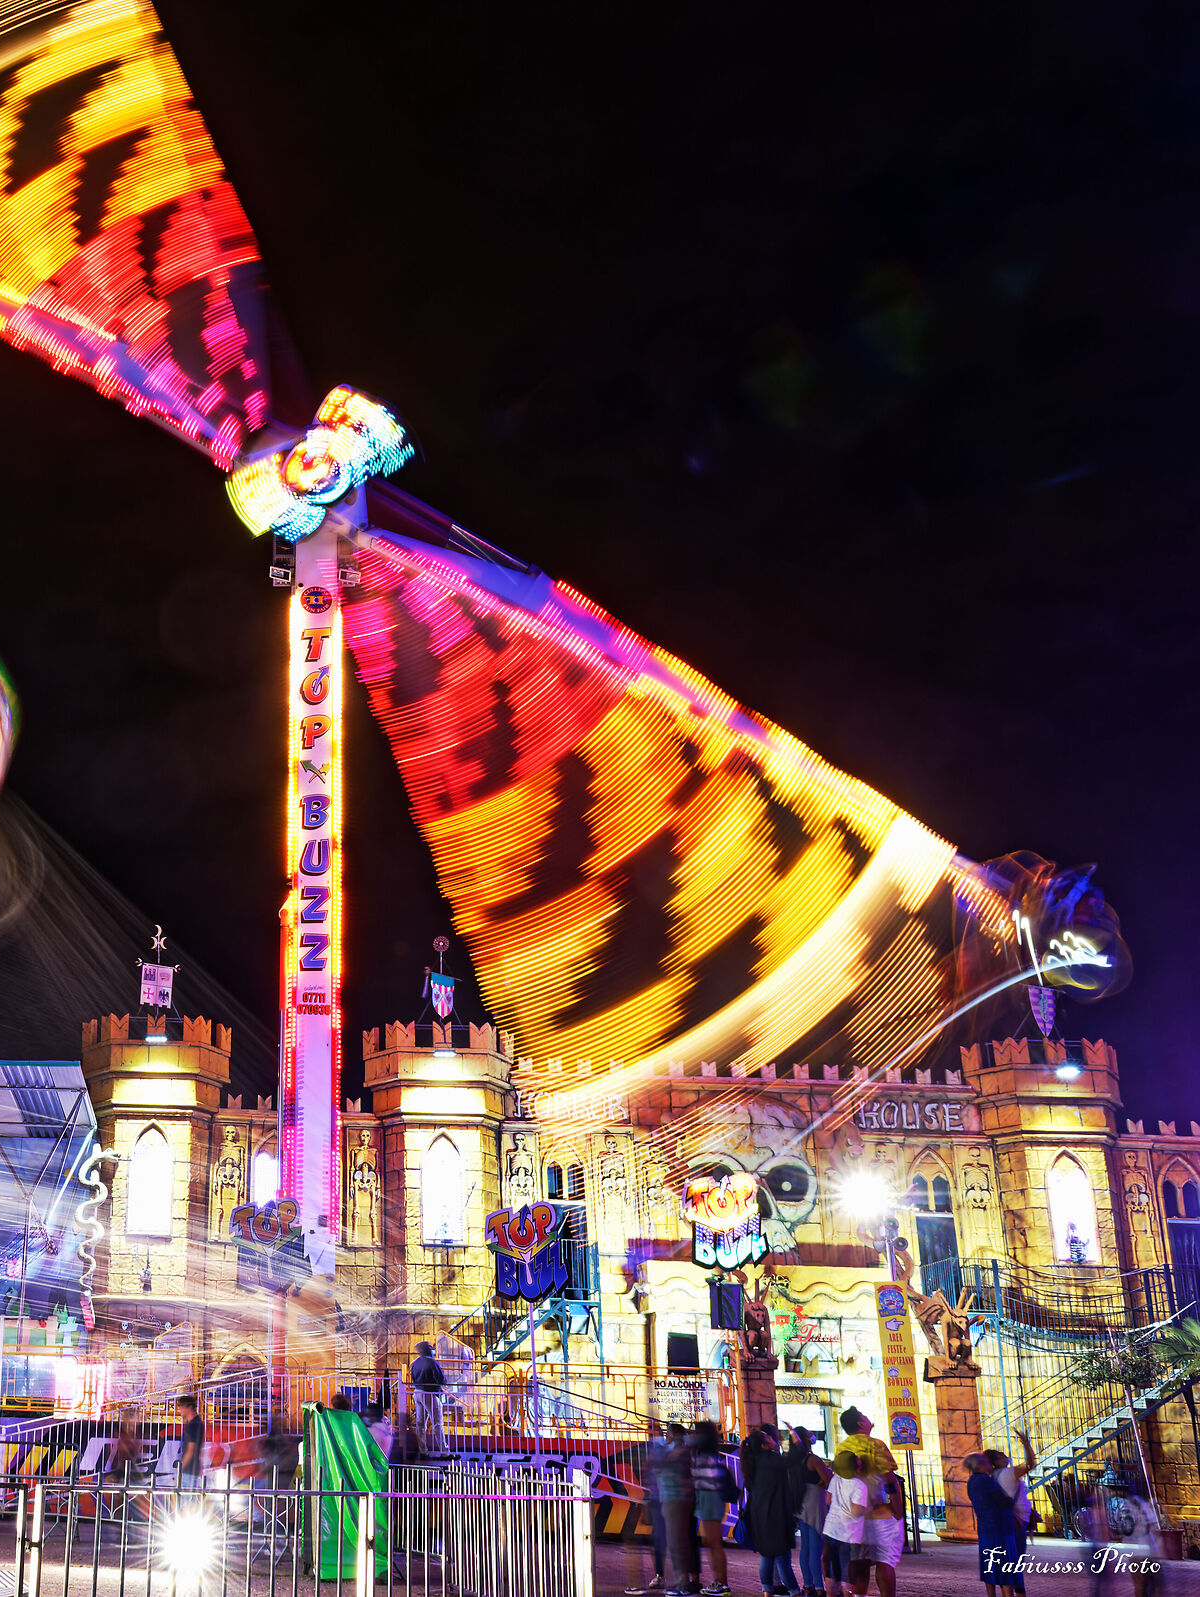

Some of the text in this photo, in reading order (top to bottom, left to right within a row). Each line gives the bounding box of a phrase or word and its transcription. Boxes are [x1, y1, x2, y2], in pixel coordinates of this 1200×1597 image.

[300, 626, 332, 750] TOP
[300, 794, 332, 971] BUZZ
[303, 992, 326, 1003] 07711
[858, 1101, 964, 1131] HOUSE
[683, 1173, 755, 1219] TOP
[231, 1200, 298, 1243] TOP
[486, 1203, 554, 1250] TOP
[692, 1213, 769, 1271] BUZZ
[496, 1242, 568, 1302] BUZZ
[889, 1333, 903, 1342] AREA
[654, 1380, 666, 1388] NO
[888, 1378, 913, 1387] BOWLING
[888, 1398, 916, 1407] BIRRERIA
